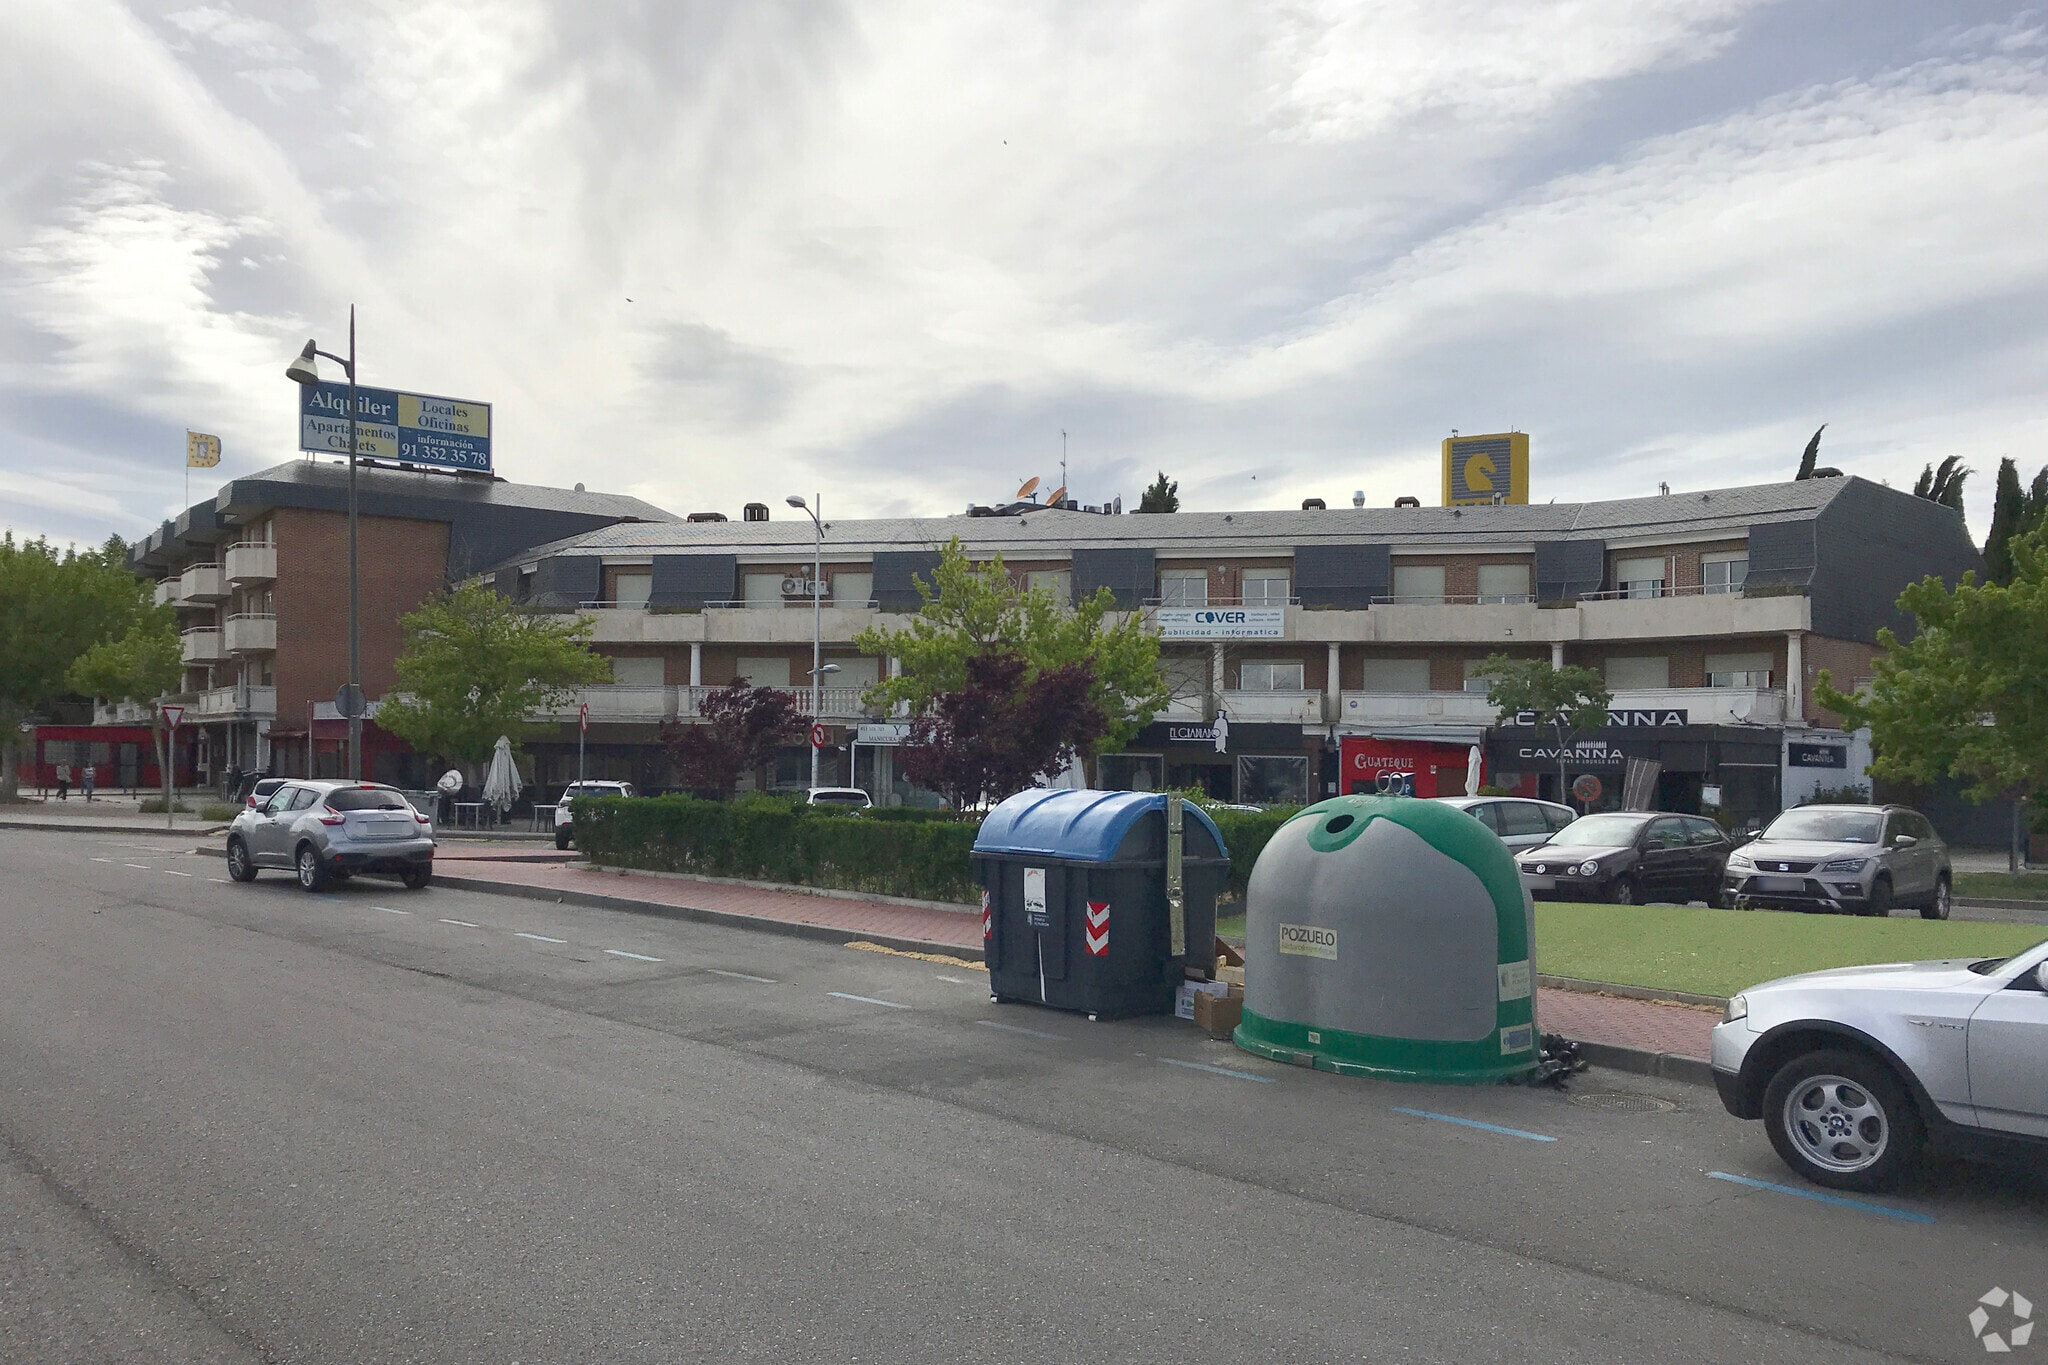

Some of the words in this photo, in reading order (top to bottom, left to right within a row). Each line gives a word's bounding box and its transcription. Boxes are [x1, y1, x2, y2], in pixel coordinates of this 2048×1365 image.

[422, 401, 468, 418] Locales
[306, 419, 396, 440] Apartamentos
[418, 415, 469, 433] Oficinas
[417, 434, 474, 450] información
[401, 443, 417, 457] 91
[422, 445, 447, 460] 352
[450, 449, 467, 463] 35
[470, 452, 487, 465] 78
[1195, 611, 1246, 624] COVER
[1162, 628, 1212, 637] publicidad
[1516, 711, 1684, 727] CAVNNA
[1169, 727, 1177, 738] EL
[1354, 753, 1414, 769] GUATEQUE
[1519, 748, 1624, 759] CAVANNA
[1281, 927, 1335, 946] POZUELO
